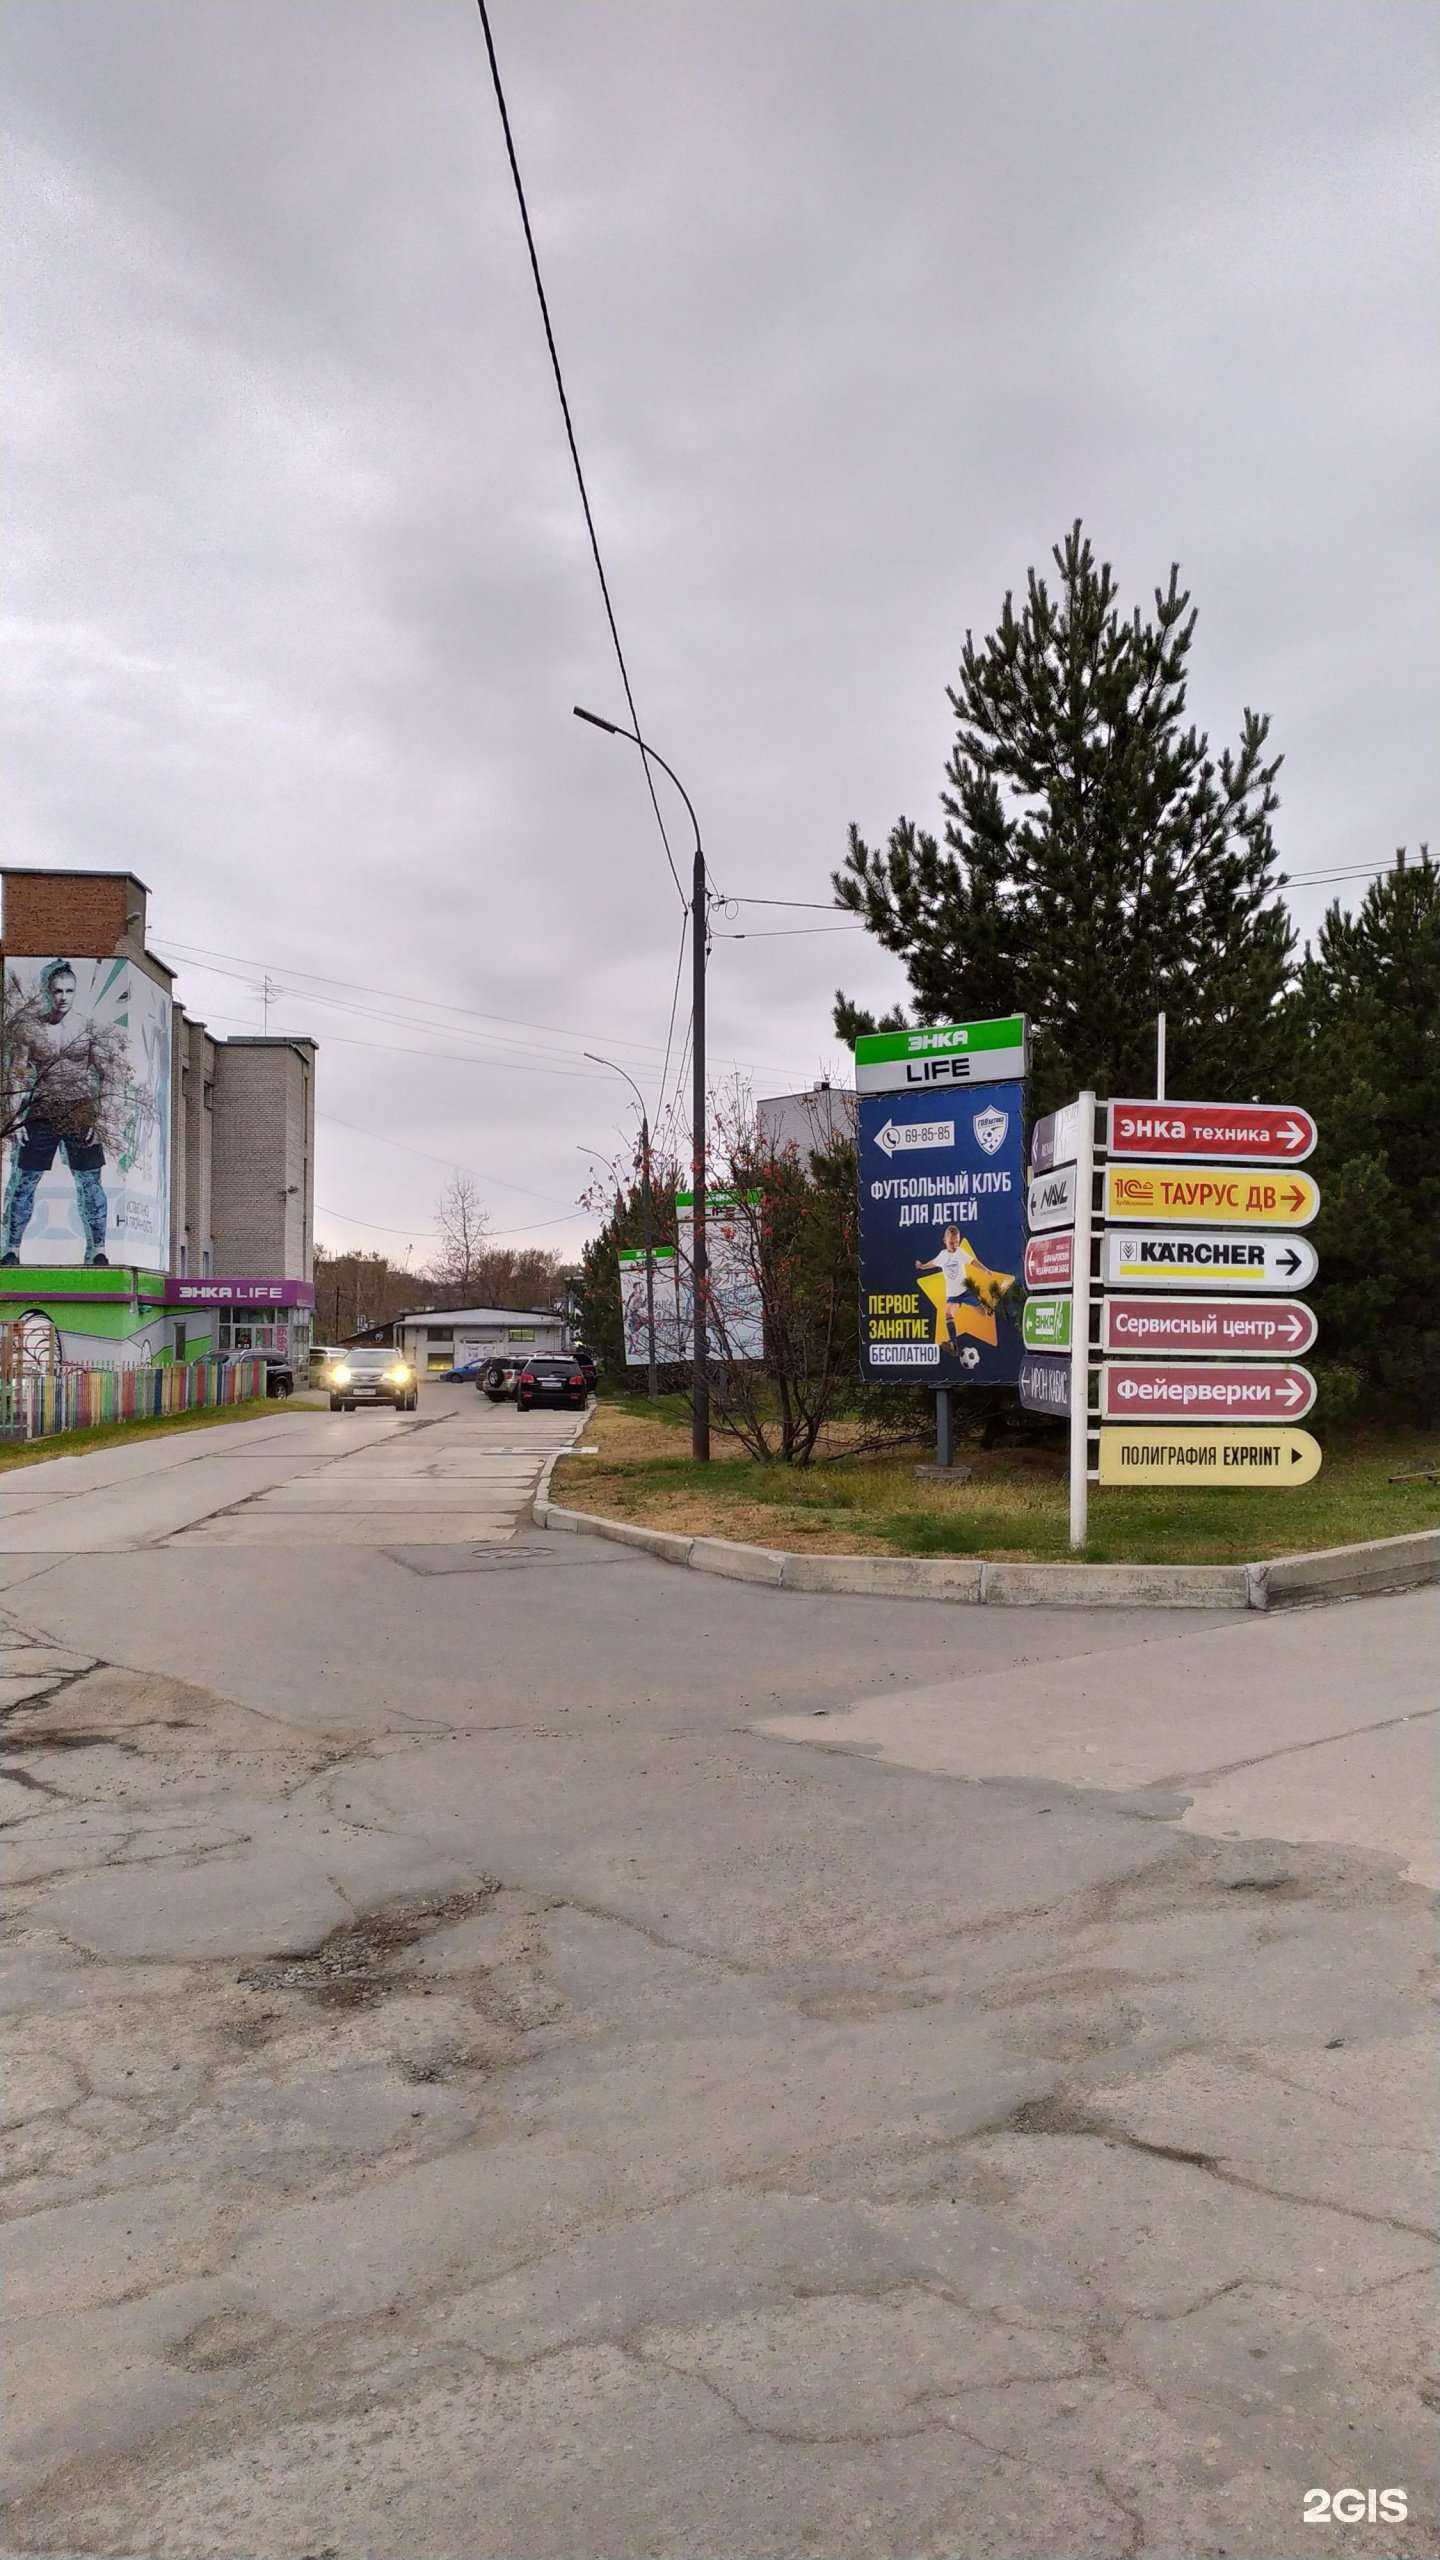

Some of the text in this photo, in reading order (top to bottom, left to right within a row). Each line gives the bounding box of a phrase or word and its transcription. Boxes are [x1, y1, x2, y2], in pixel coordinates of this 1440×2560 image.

[908, 1030, 968, 1051] ЭНКА
[907, 1058, 970, 1082] LIFE
[905, 1126, 950, 1143] 69-85-85
[1193, 1127, 1270, 1142] техника
[870, 1171, 1012, 1200] ФУТБОЛЬНЫЙ КЛУБ
[1160, 1183, 1239, 1206] ТАУРУС
[1246, 1186, 1277, 1211] ДВ
[899, 1198, 978, 1227] ДЛЯ ДЕТЕЙ
[1141, 1242, 1265, 1265] KÄRCHER
[179, 1287, 283, 1298] ЭНКА LIFE
[868, 1294, 920, 1315] ПЕРВОЕ
[868, 1319, 930, 1339] ЗАНЯТИЕ
[1116, 1313, 1276, 1340] Сервисный центр
[871, 1345, 938, 1362] БЕСПЛАТНО!
[1117, 1378, 1271, 1405] Фейерверки
[1121, 1446, 1281, 1466] ПОЛИГРАФИЯ EXPRINT
